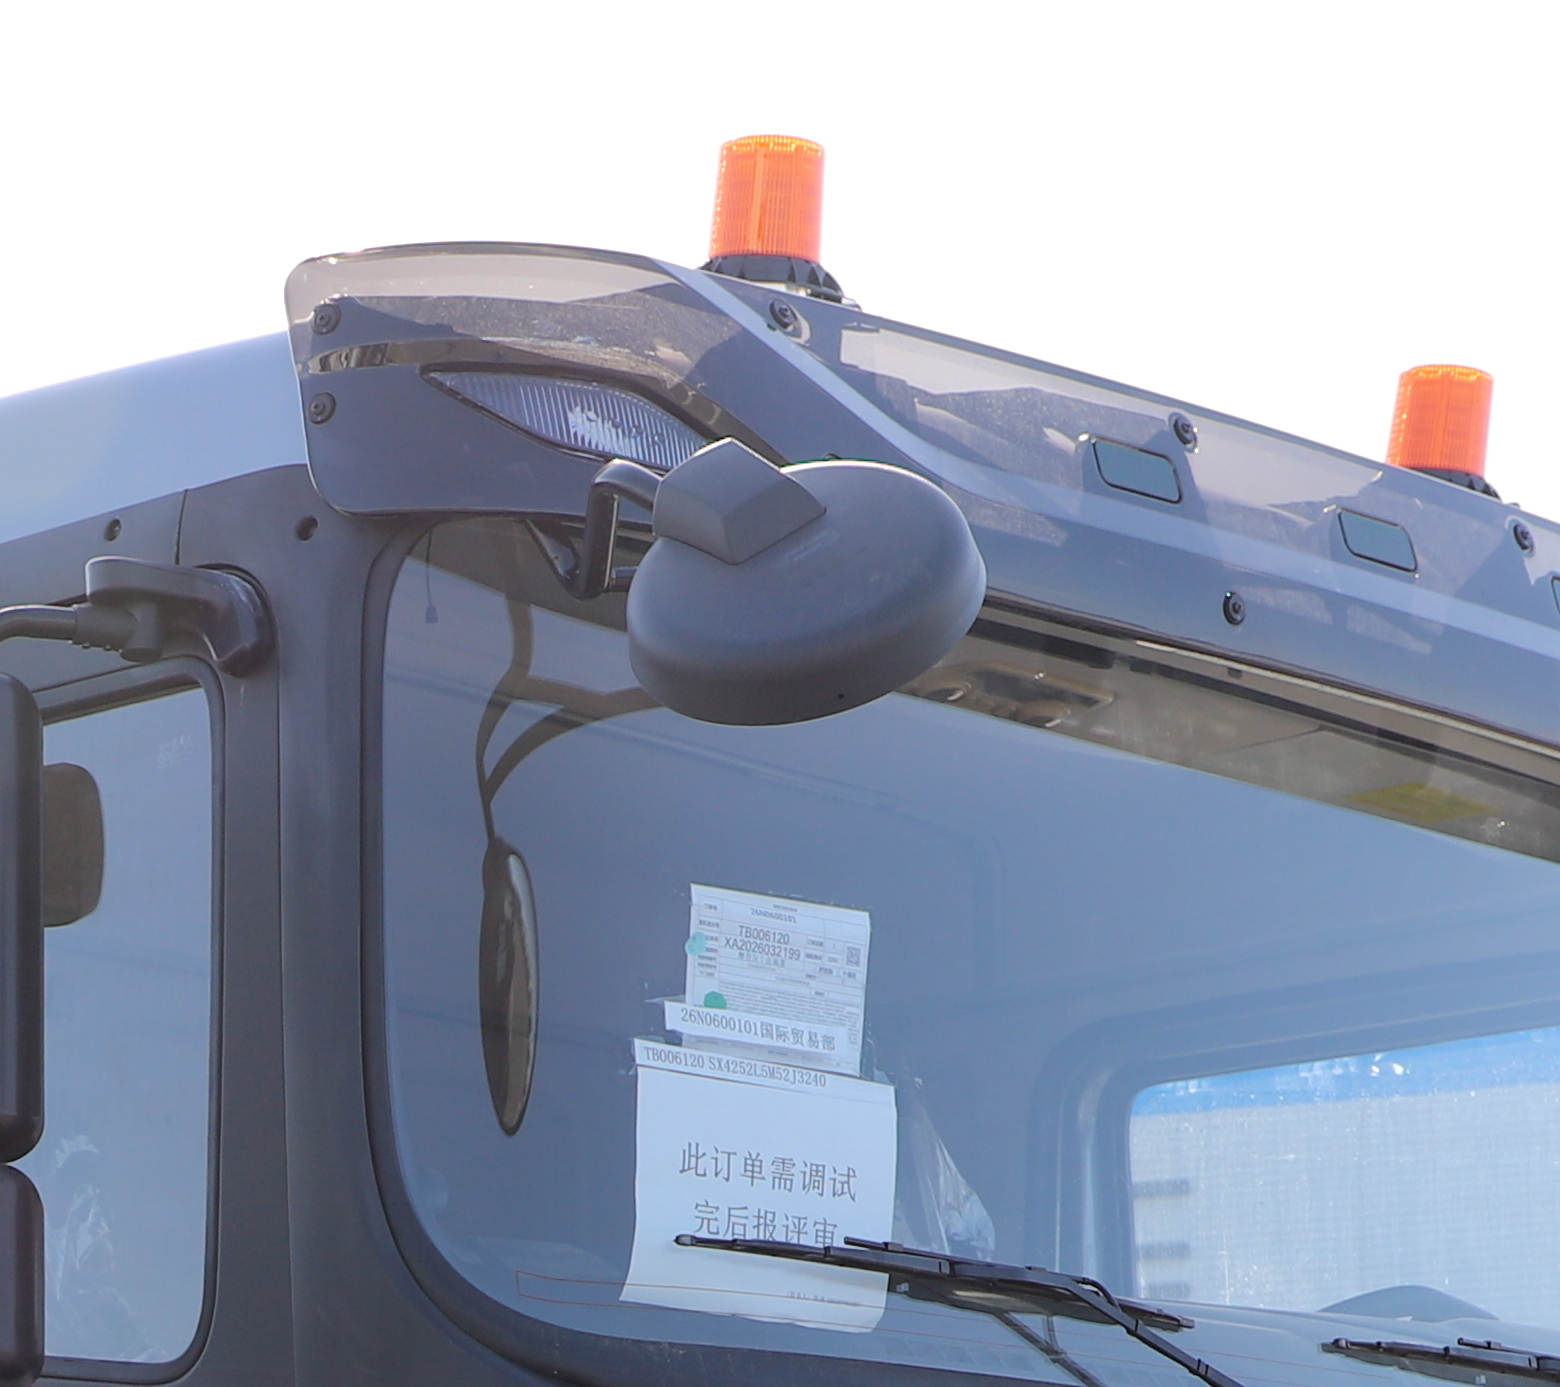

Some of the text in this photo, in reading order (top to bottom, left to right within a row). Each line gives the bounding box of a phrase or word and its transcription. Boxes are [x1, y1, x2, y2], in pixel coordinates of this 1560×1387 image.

[724, 936, 801, 960] XA2026032199
[738, 925, 790, 946] TB006120
[680, 1007, 836, 1052] 26N0600101国际贸易部
[643, 1046, 827, 1088] TB006120 SX4252L5M52J3240
[678, 1141, 858, 1203] 此订单需调试
[693, 1199, 839, 1248] 完后报评审
